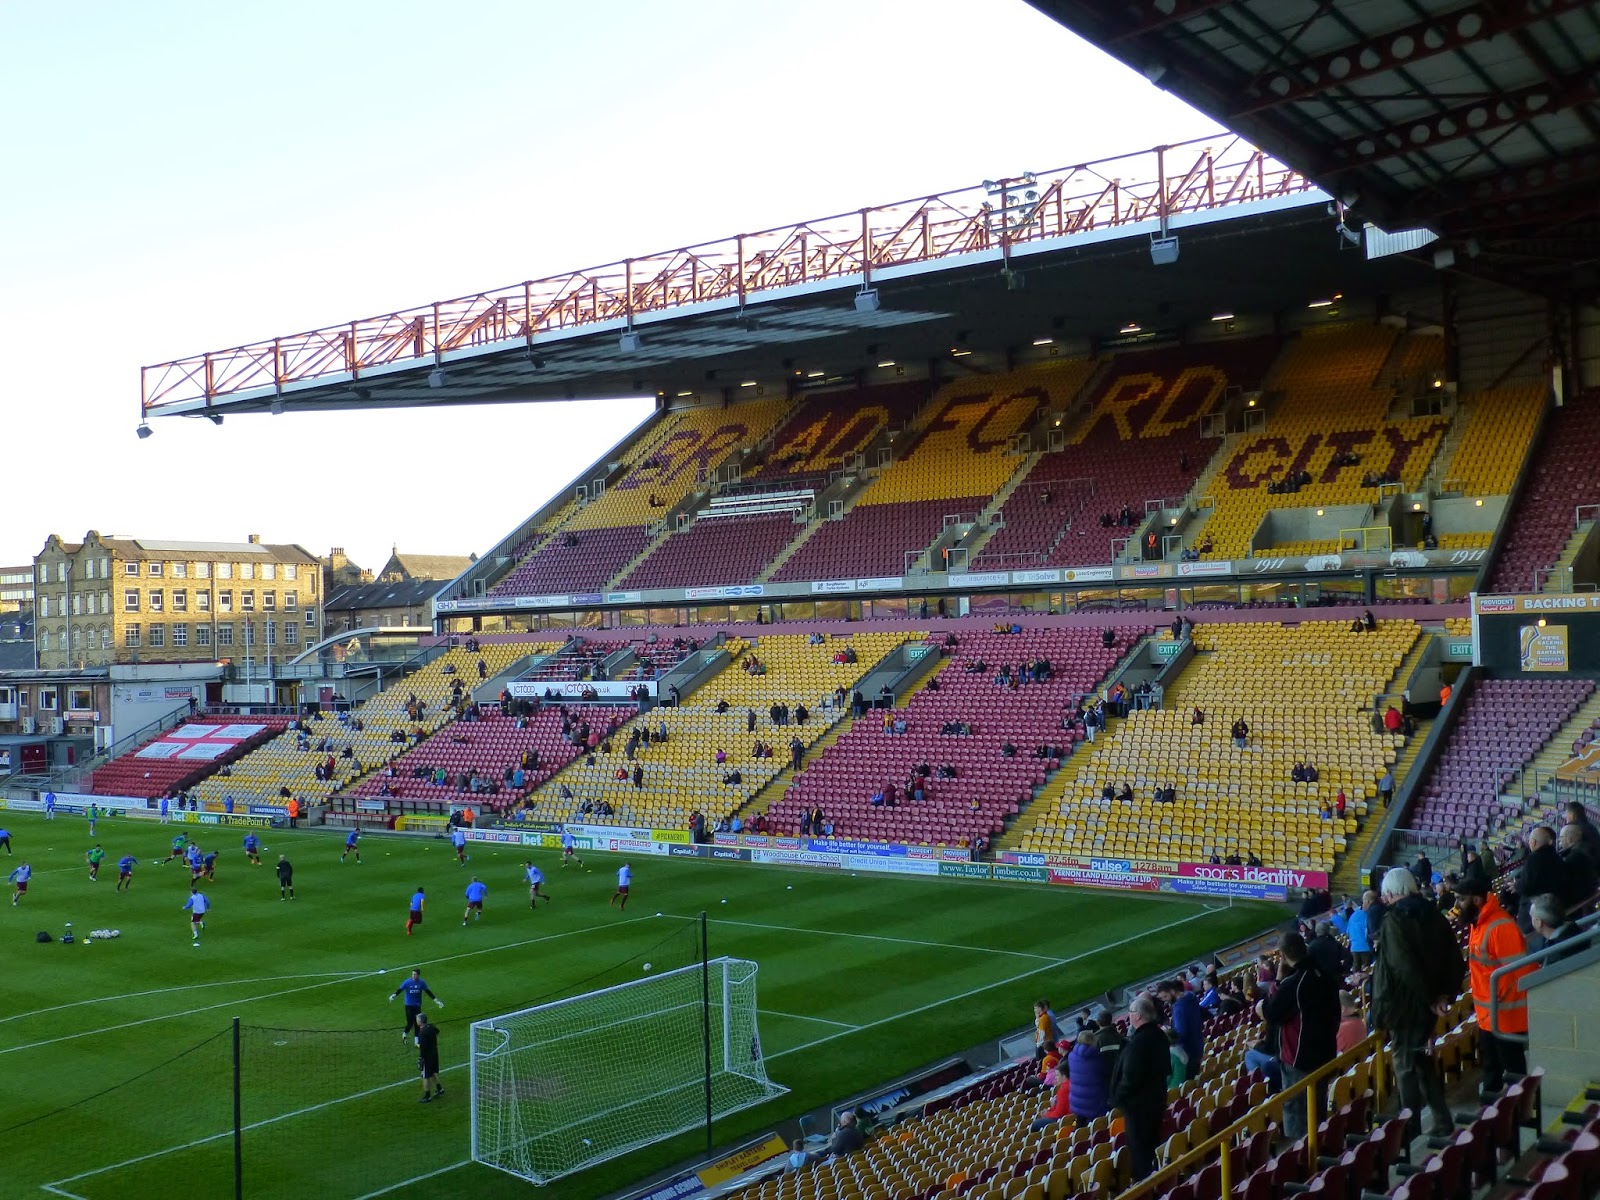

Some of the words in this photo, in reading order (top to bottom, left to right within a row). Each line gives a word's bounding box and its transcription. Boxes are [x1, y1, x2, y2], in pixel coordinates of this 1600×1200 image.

[1450, 549, 1486, 565] 1911
[1254, 558, 1286, 573] 1911
[437, 601, 457, 610] GHX
[1480, 598, 1514, 606] PROVIDENT
[1523, 597, 1588, 610] BACKING
[1159, 645, 1174, 654] EXIT
[1451, 645, 1468, 655] EXIT
[172, 812, 218, 825] bet365.com
[227, 816, 264, 826] TradePoint
[476, 832, 485, 841] sky
[485, 832, 497, 840] BET
[498, 833, 508, 843] sky
[508, 834, 520, 842] BET
[586, 830, 600, 838] Building
[523, 834, 592, 850] bet365.om
[813, 839, 828, 847] Make
[828, 840, 838, 848] life
[838, 841, 857, 849] better
[857, 842, 866, 850] for
[866, 843, 891, 852] yourself.
[762, 850, 799, 859] Woodhouse
[799, 851, 818, 860] Grove
[818, 853, 840, 862] School
[907, 846, 932, 855] PROVIDENT
[943, 849, 969, 858] PROVIDENT
[850, 856, 870, 866] Credit
[870, 858, 888, 867] Union
[1018, 853, 1045, 867] pulse
[1048, 855, 1079, 866] 97.5fm
[1134, 861, 1172, 873] 1278am
[1053, 869, 1081, 879] VERNON
[1082, 871, 1100, 880] LAND
[1100, 872, 1140, 883] TRANSPORT
[1140, 874, 1152, 884] LTD
[1243, 866, 1306, 888] identity
[1177, 879, 1195, 887] Make
[1195, 879, 1207, 887] life
[1208, 880, 1228, 889] better
[1238, 882, 1268, 893] yourself.
[716, 1156, 740, 1171] SHIPLEY
[739, 1144, 766, 1161] BANTAMS
[730, 1158, 748, 1172] TRAVEL
[747, 1155, 761, 1166] CLUB
[652, 1185, 677, 1200] RIDING
[674, 1176, 703, 1196] SCHOOL
